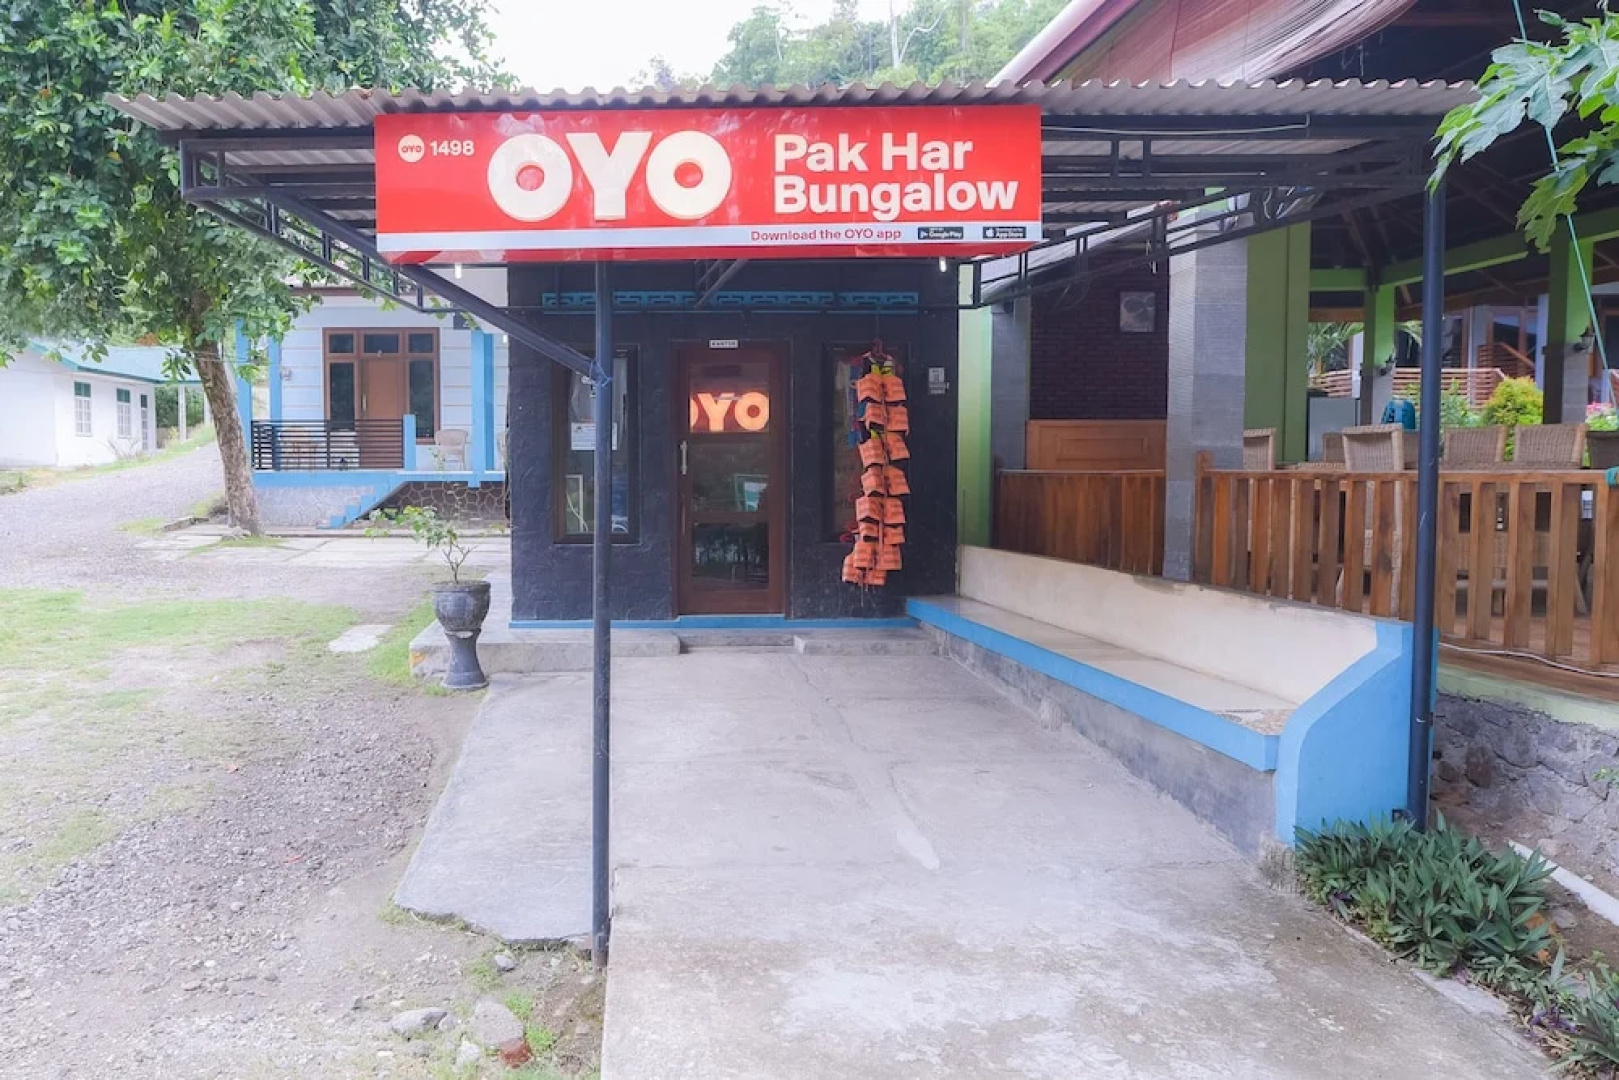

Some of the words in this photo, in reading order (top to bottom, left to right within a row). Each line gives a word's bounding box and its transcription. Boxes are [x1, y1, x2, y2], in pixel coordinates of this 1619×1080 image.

[429, 139, 475, 156] 1498
[774, 132, 869, 173] Pak
[881, 132, 973, 171] Har
[487, 130, 732, 222] OYO
[774, 173, 1019, 222] Bungalow
[751, 230, 817, 241] Download
[820, 229, 842, 239] the
[844, 228, 874, 239] OYO
[876, 229, 902, 241] app
[690, 391, 770, 432] YO
